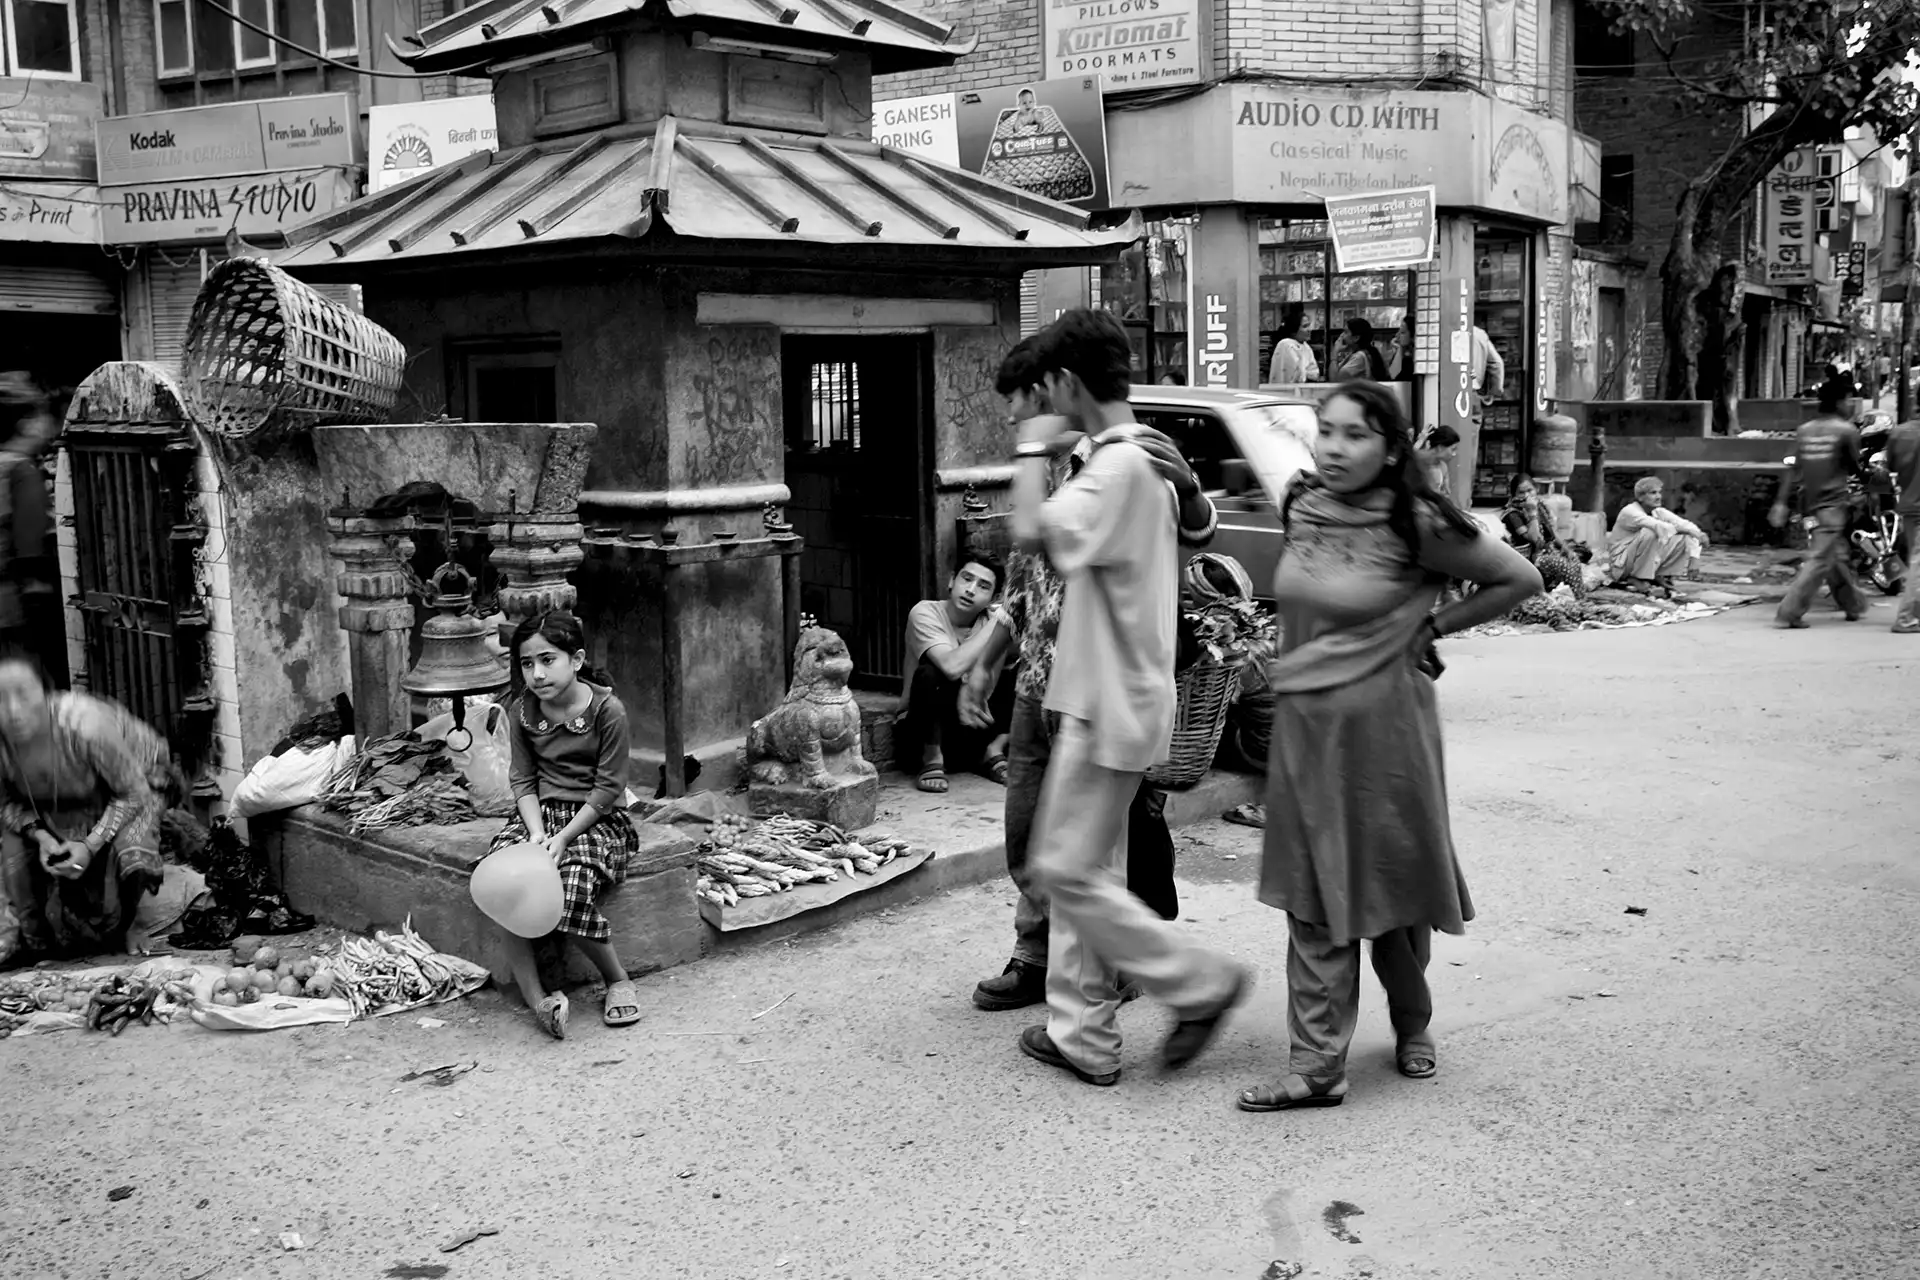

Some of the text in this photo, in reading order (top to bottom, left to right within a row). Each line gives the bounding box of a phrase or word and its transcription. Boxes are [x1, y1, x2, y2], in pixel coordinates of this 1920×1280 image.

[1079, 0, 1160, 20] PILLOWS
[1063, 48, 1176, 72] DOORMATS
[884, 103, 951, 126] GANESH
[130, 130, 176, 151] Kodak
[268, 116, 344, 142] Pravina Studio
[1270, 141, 1408, 162] Classical Music
[29, 199, 81, 231] Print
[123, 187, 222, 224] PRAVINA
[1455, 278, 1470, 418] COIUFF
